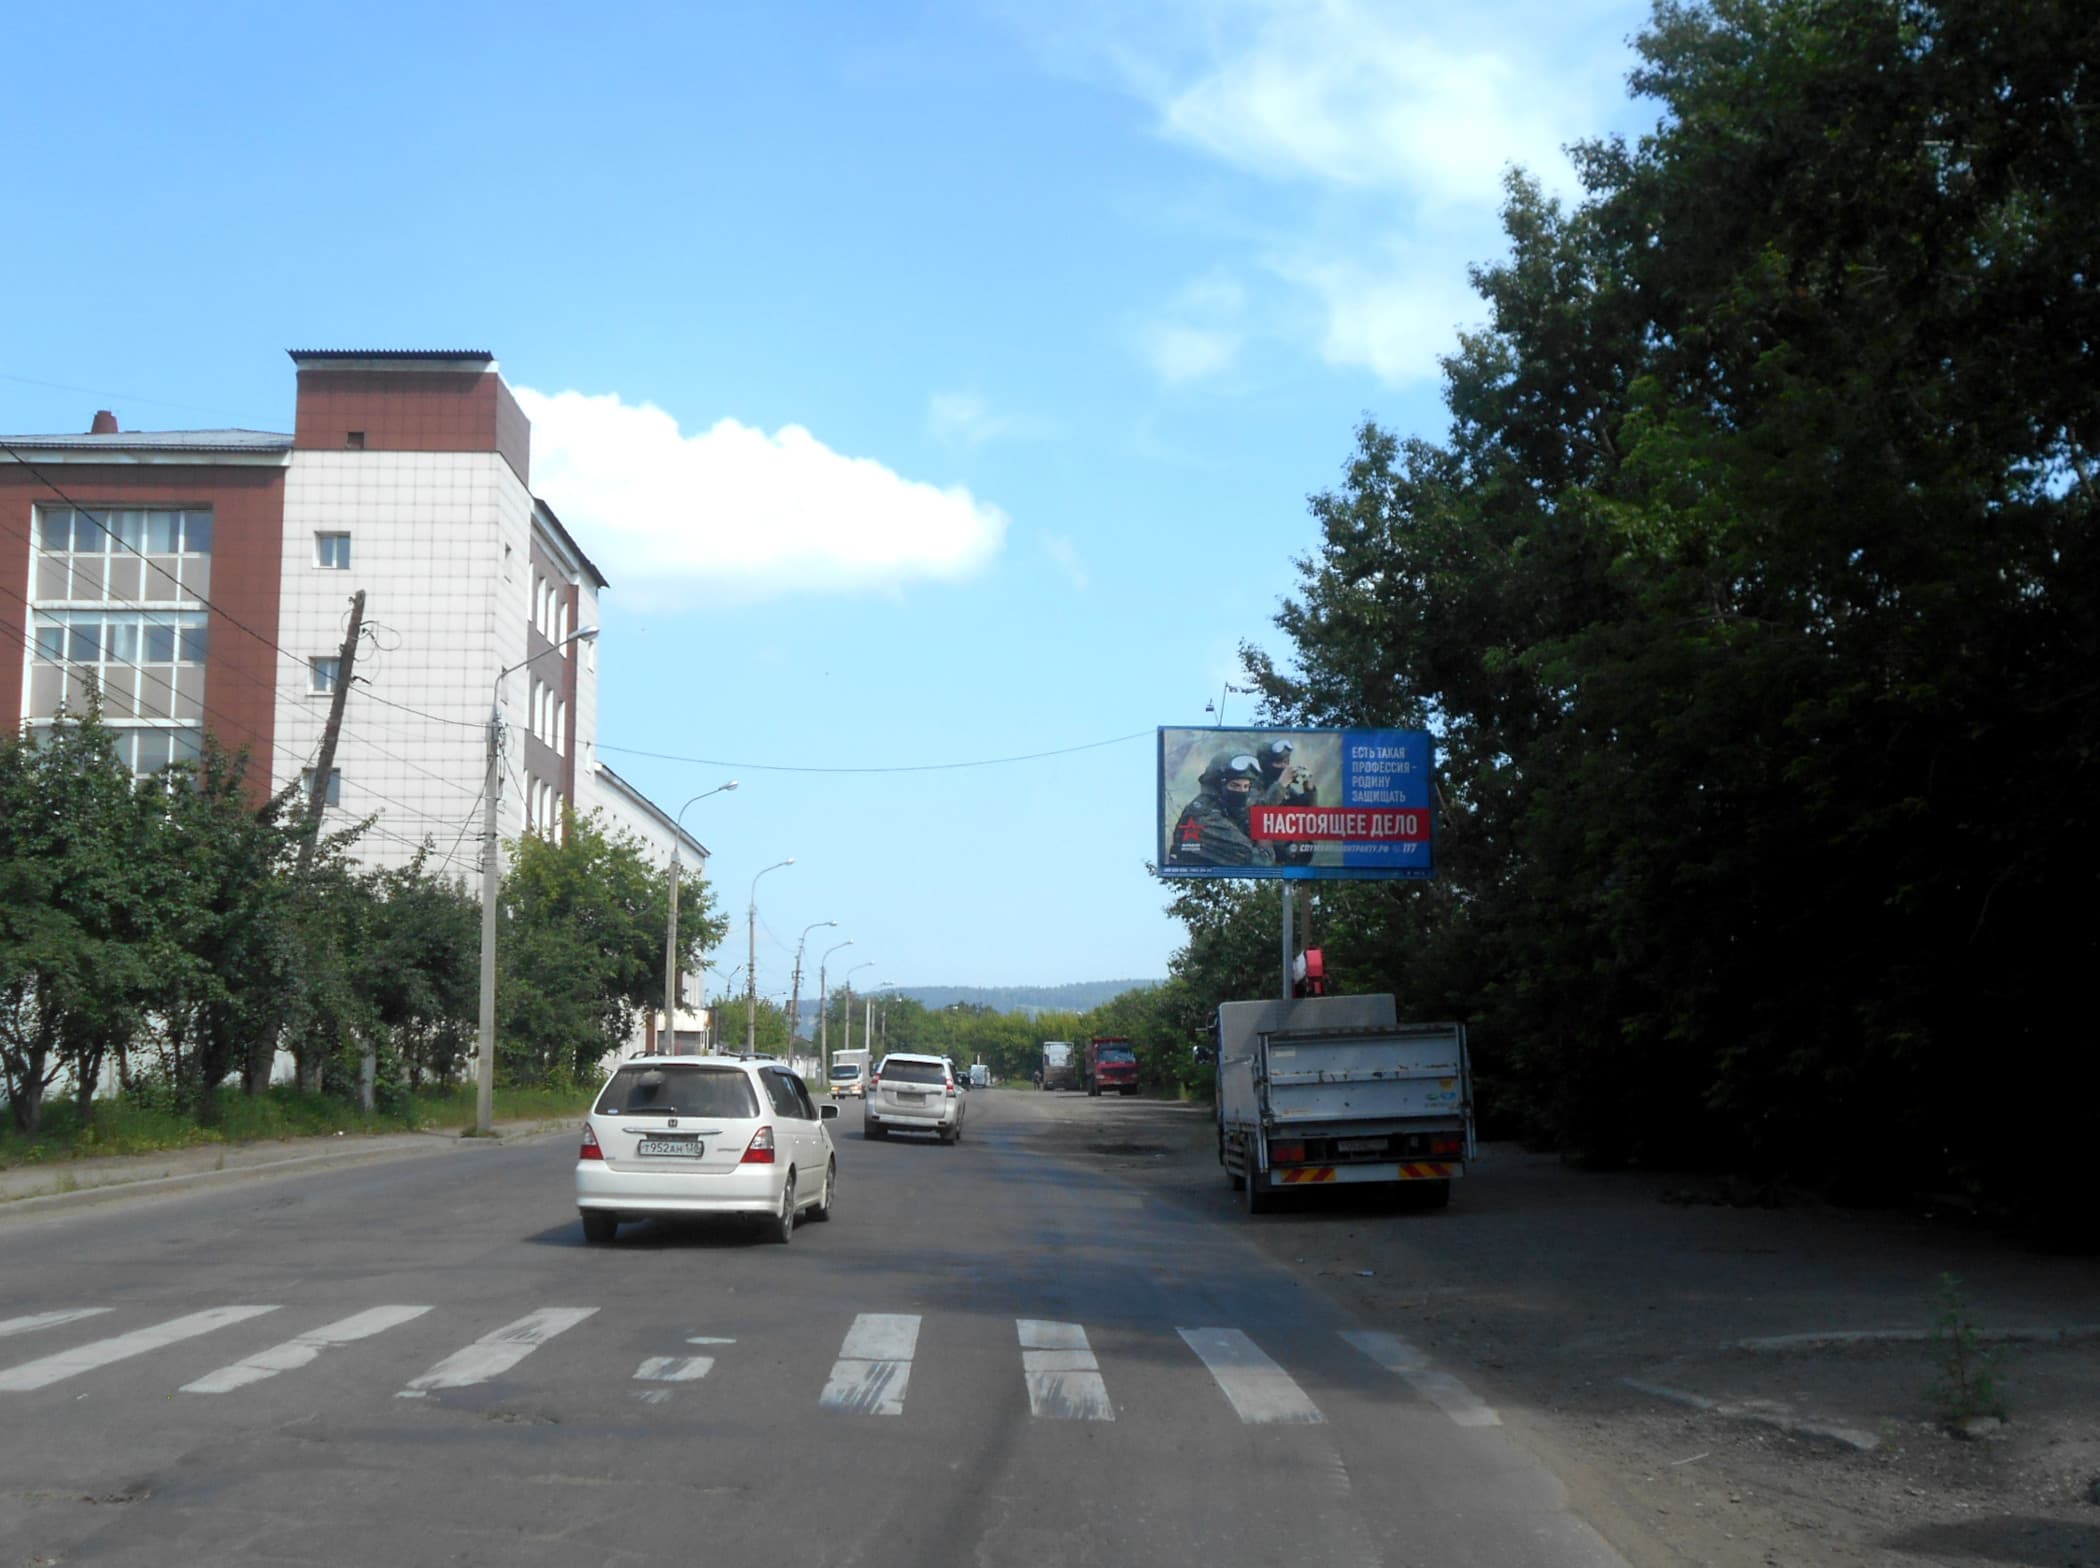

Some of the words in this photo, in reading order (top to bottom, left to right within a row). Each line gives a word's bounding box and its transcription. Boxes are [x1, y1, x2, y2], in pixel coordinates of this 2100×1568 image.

[1352, 746, 1375, 759] ЕСТЬ
[1377, 747, 1405, 759] ТАКАЯ
[1352, 761, 1410, 773] ПРОФЕССИЯ
[1352, 776, 1391, 788] РОДИНУ
[1352, 790, 1406, 803] ЗАЩИЩАТЬ
[1263, 813, 1367, 837] НАСТОЯЩЕЕ
[1370, 814, 1418, 837] ДЕЛО
[1402, 843, 1417, 854] 117
